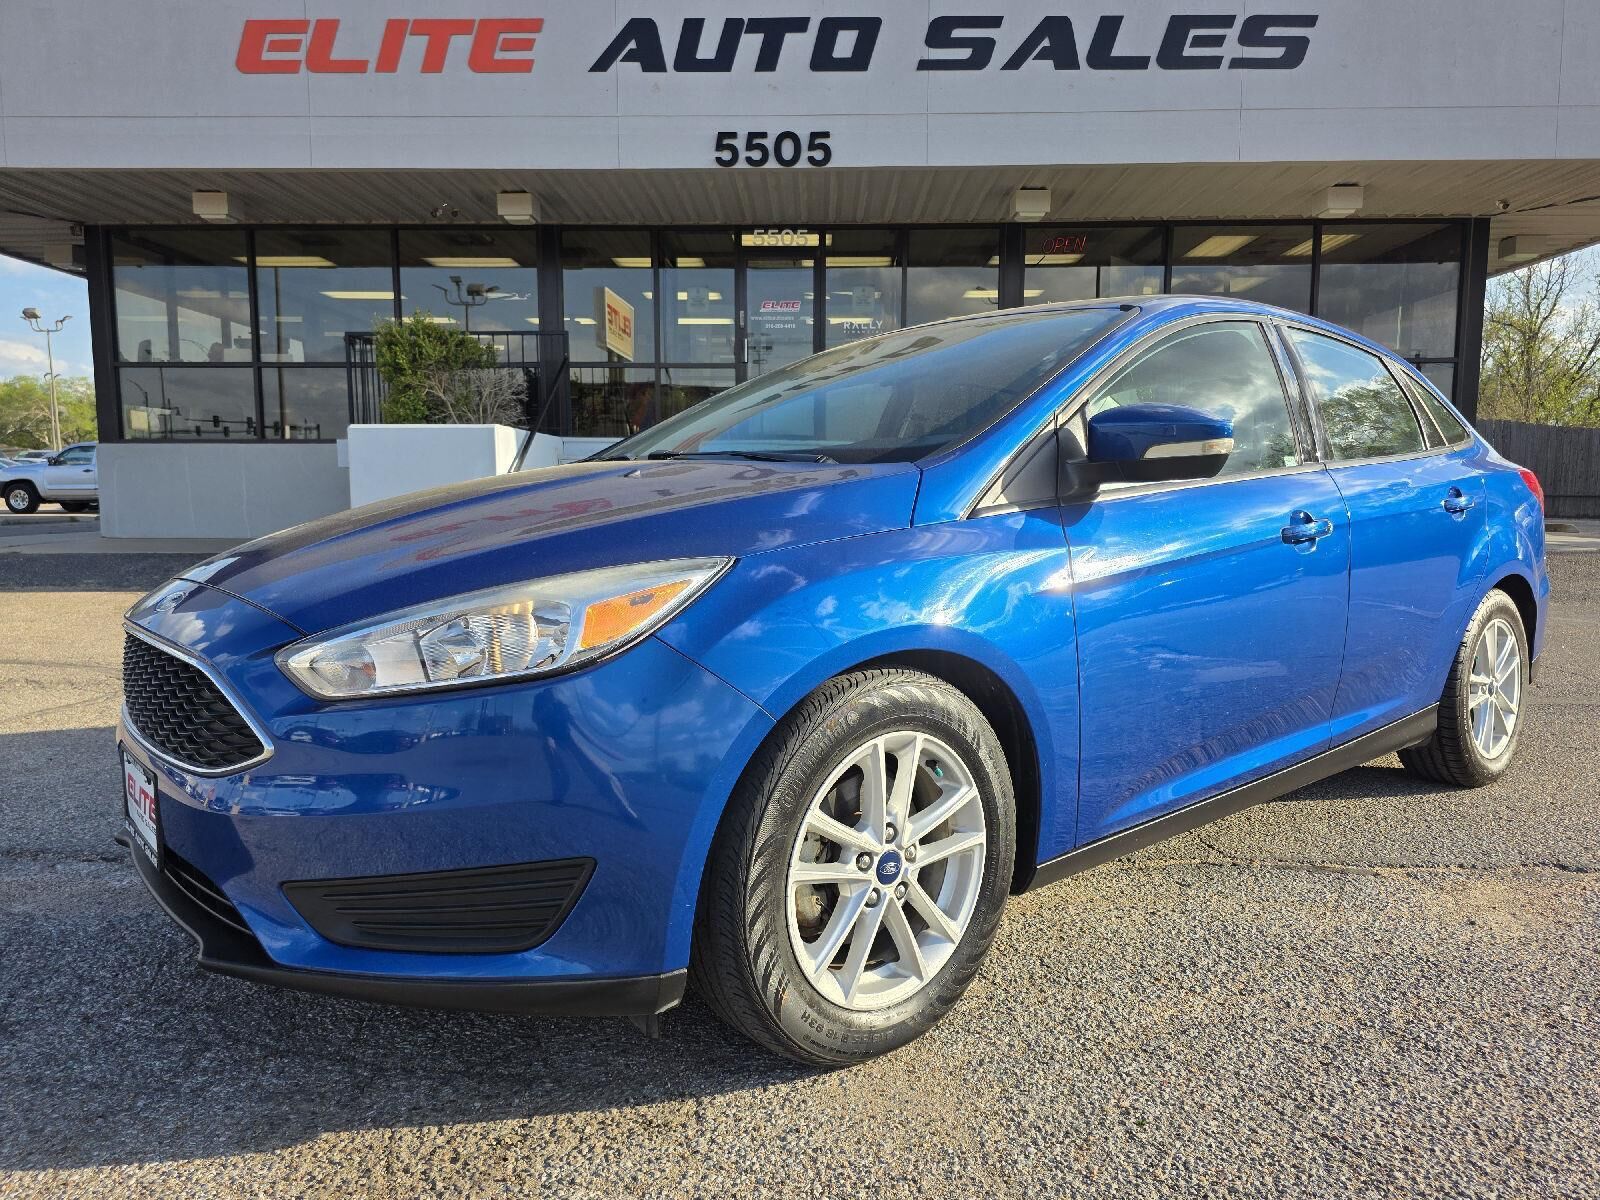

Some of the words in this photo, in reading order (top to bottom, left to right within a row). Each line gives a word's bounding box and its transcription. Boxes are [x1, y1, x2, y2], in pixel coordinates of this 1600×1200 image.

[236, 18, 543, 73] ELITE
[588, 17, 882, 72] AUTO
[916, 15, 1318, 71] SALES
[715, 131, 832, 167] 5505
[753, 229, 808, 246] 5505
[1043, 235, 1087, 253] OPEN
[761, 300, 801, 309] ELITE
[843, 320, 883, 330] RALLY
[128, 772, 157, 827] ELITE
